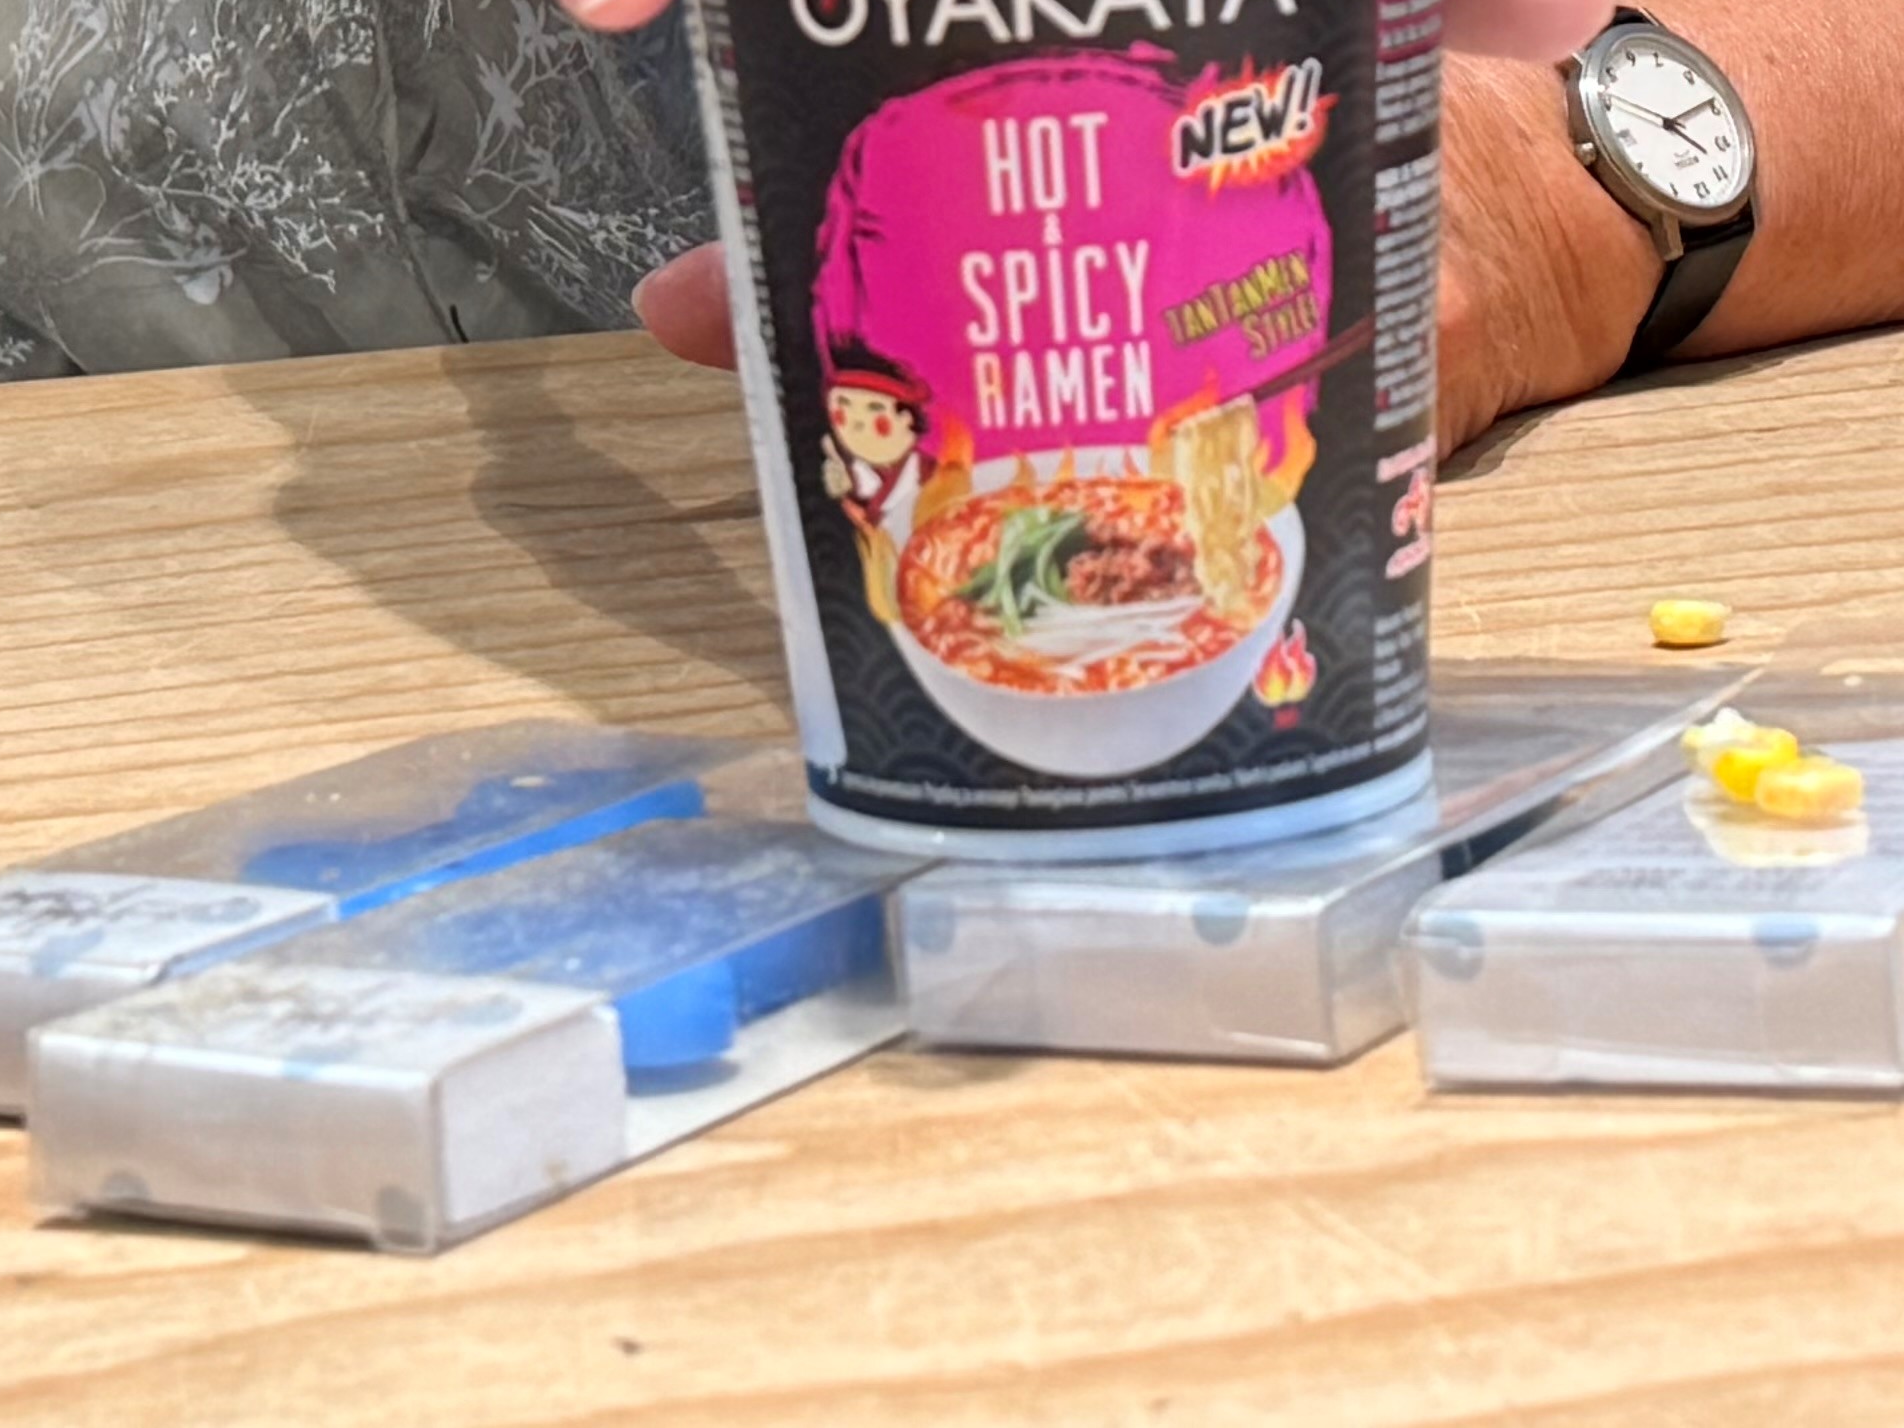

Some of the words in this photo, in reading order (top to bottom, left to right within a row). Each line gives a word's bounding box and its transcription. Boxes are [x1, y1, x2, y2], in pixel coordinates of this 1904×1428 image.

[983, 112, 1108, 216] HOT
[1179, 64, 1316, 170] NEW!
[961, 240, 1150, 347] SPICY
[974, 341, 1154, 430] RAMEN
